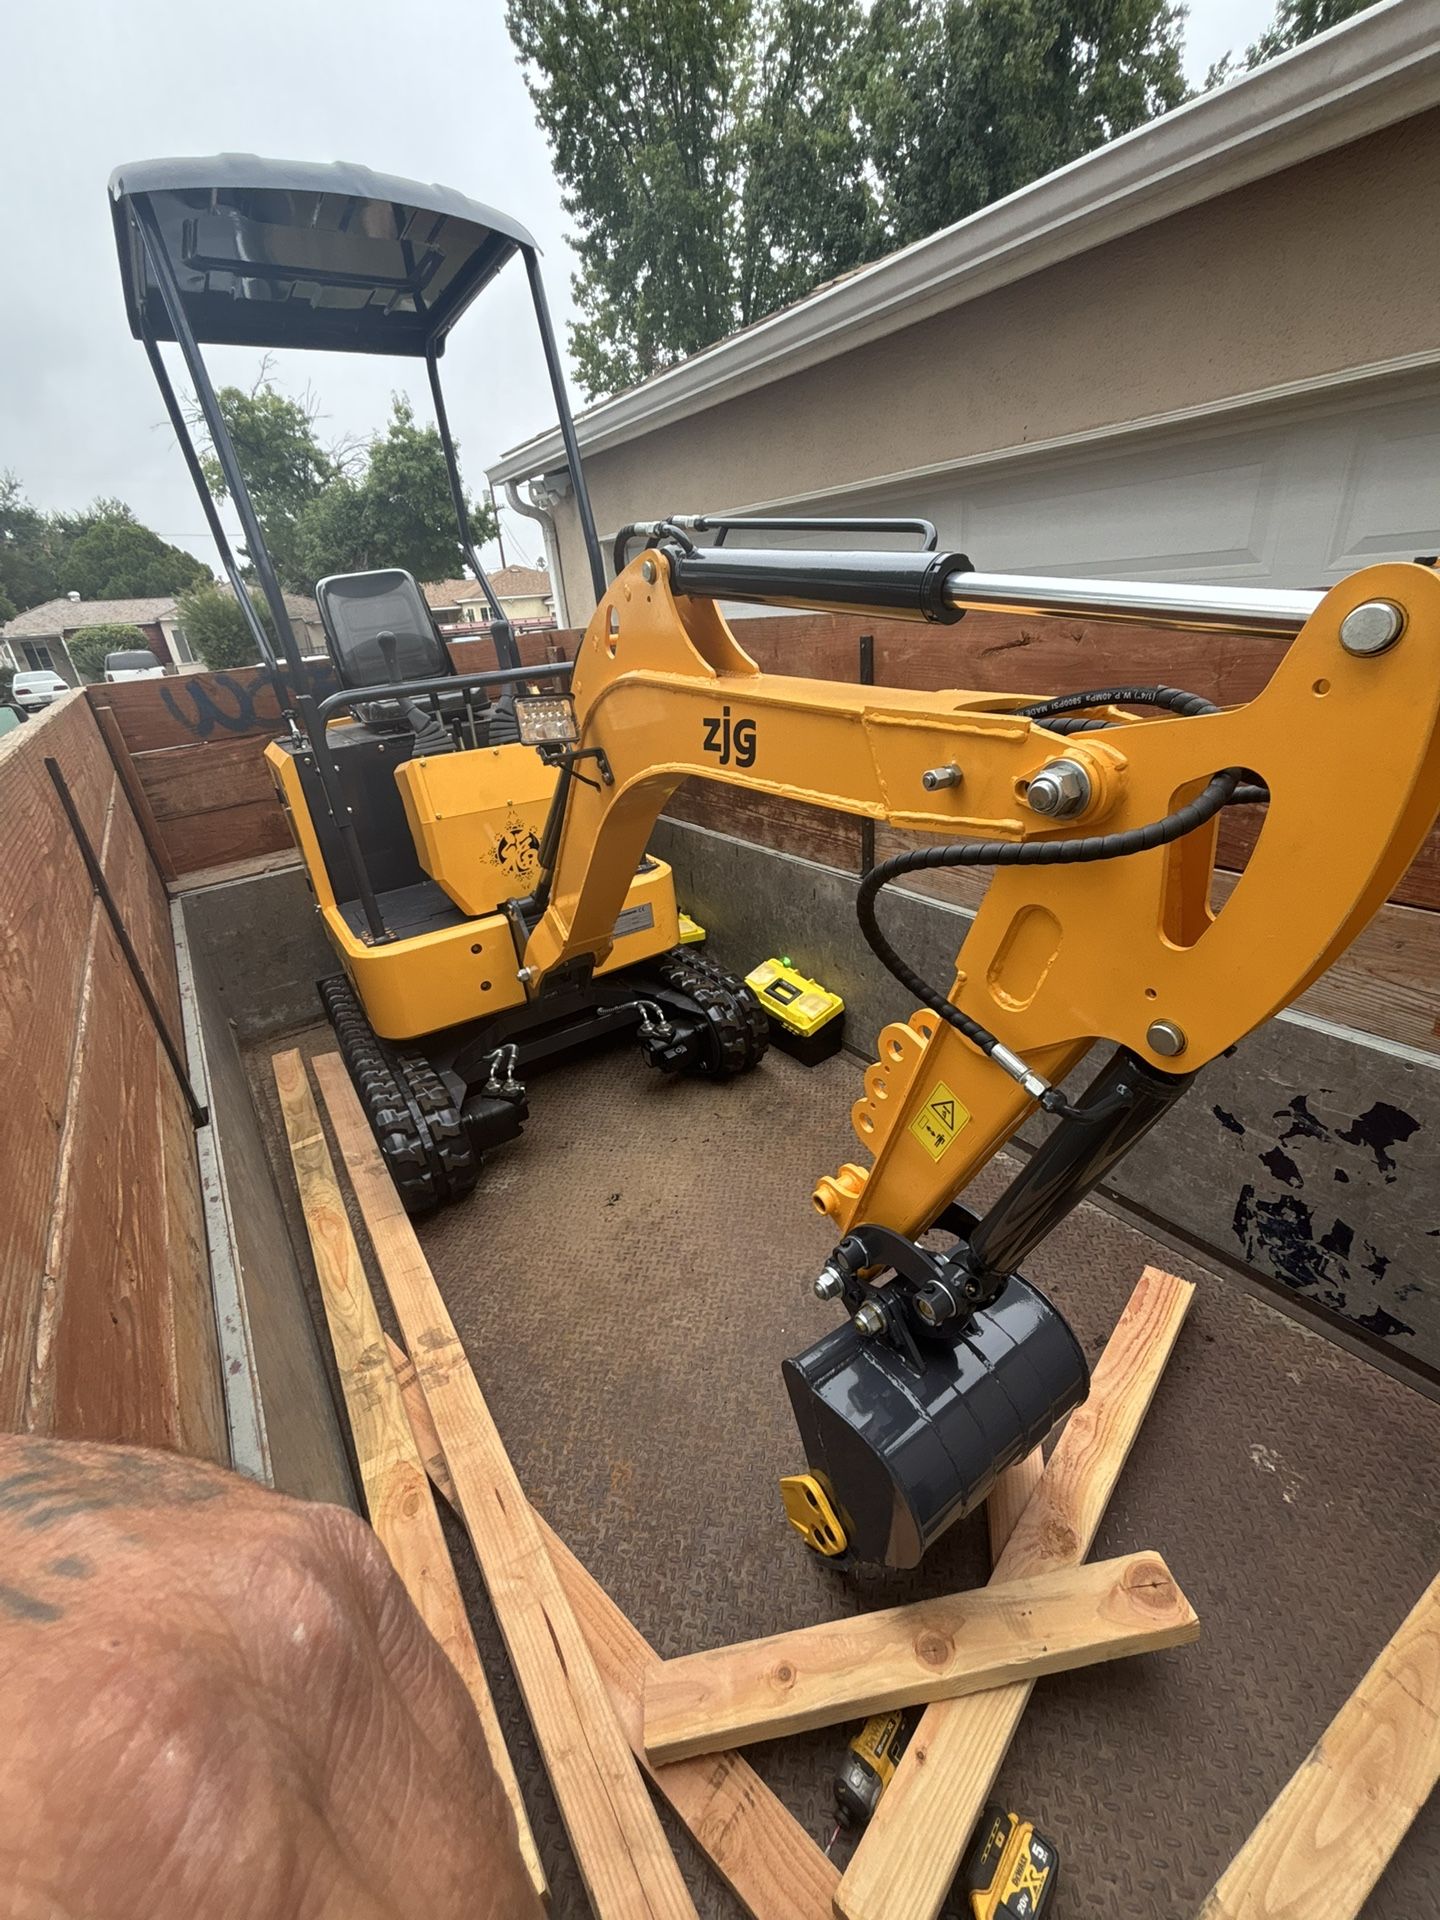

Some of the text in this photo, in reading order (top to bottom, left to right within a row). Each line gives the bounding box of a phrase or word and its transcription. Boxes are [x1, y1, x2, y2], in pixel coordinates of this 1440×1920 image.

[1025, 705, 1048, 717] MADE
[1051, 696, 1082, 710] 5800PSI
[703, 705, 757, 768] zjg
[1031, 1843, 1045, 1860] 5
[1020, 1864, 1050, 1912] XR
